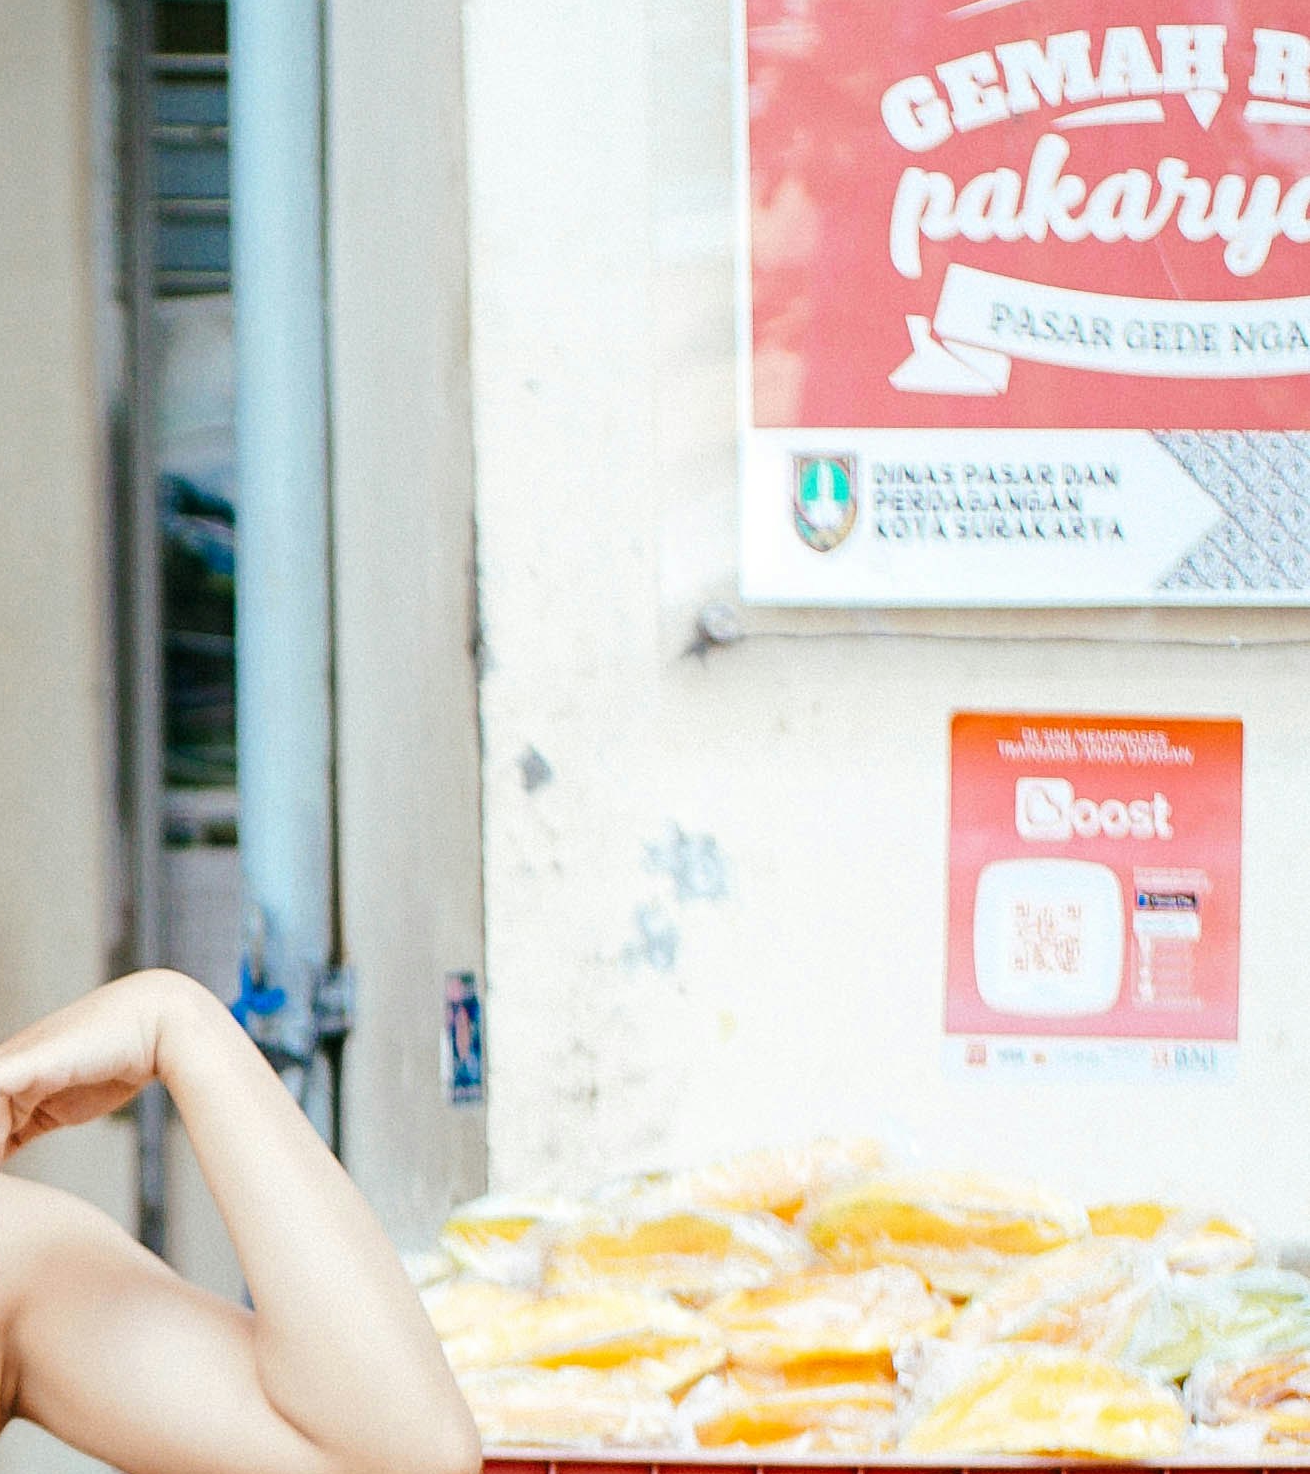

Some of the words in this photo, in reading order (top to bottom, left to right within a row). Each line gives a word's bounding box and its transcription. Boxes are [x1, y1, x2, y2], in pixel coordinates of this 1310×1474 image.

[880, 24, 1229, 152] GEMAH
[989, 302, 1113, 349] PASAR
[1124, 320, 1219, 352] GEDE
[874, 461, 954, 485] DINAS
[963, 461, 1055, 485] PASAR
[1062, 461, 1121, 485] DAN
[874, 487, 1084, 512] PERDAGANGAN
[874, 515, 949, 540] KOTA
[956, 515, 1126, 540] SURAKARTA
